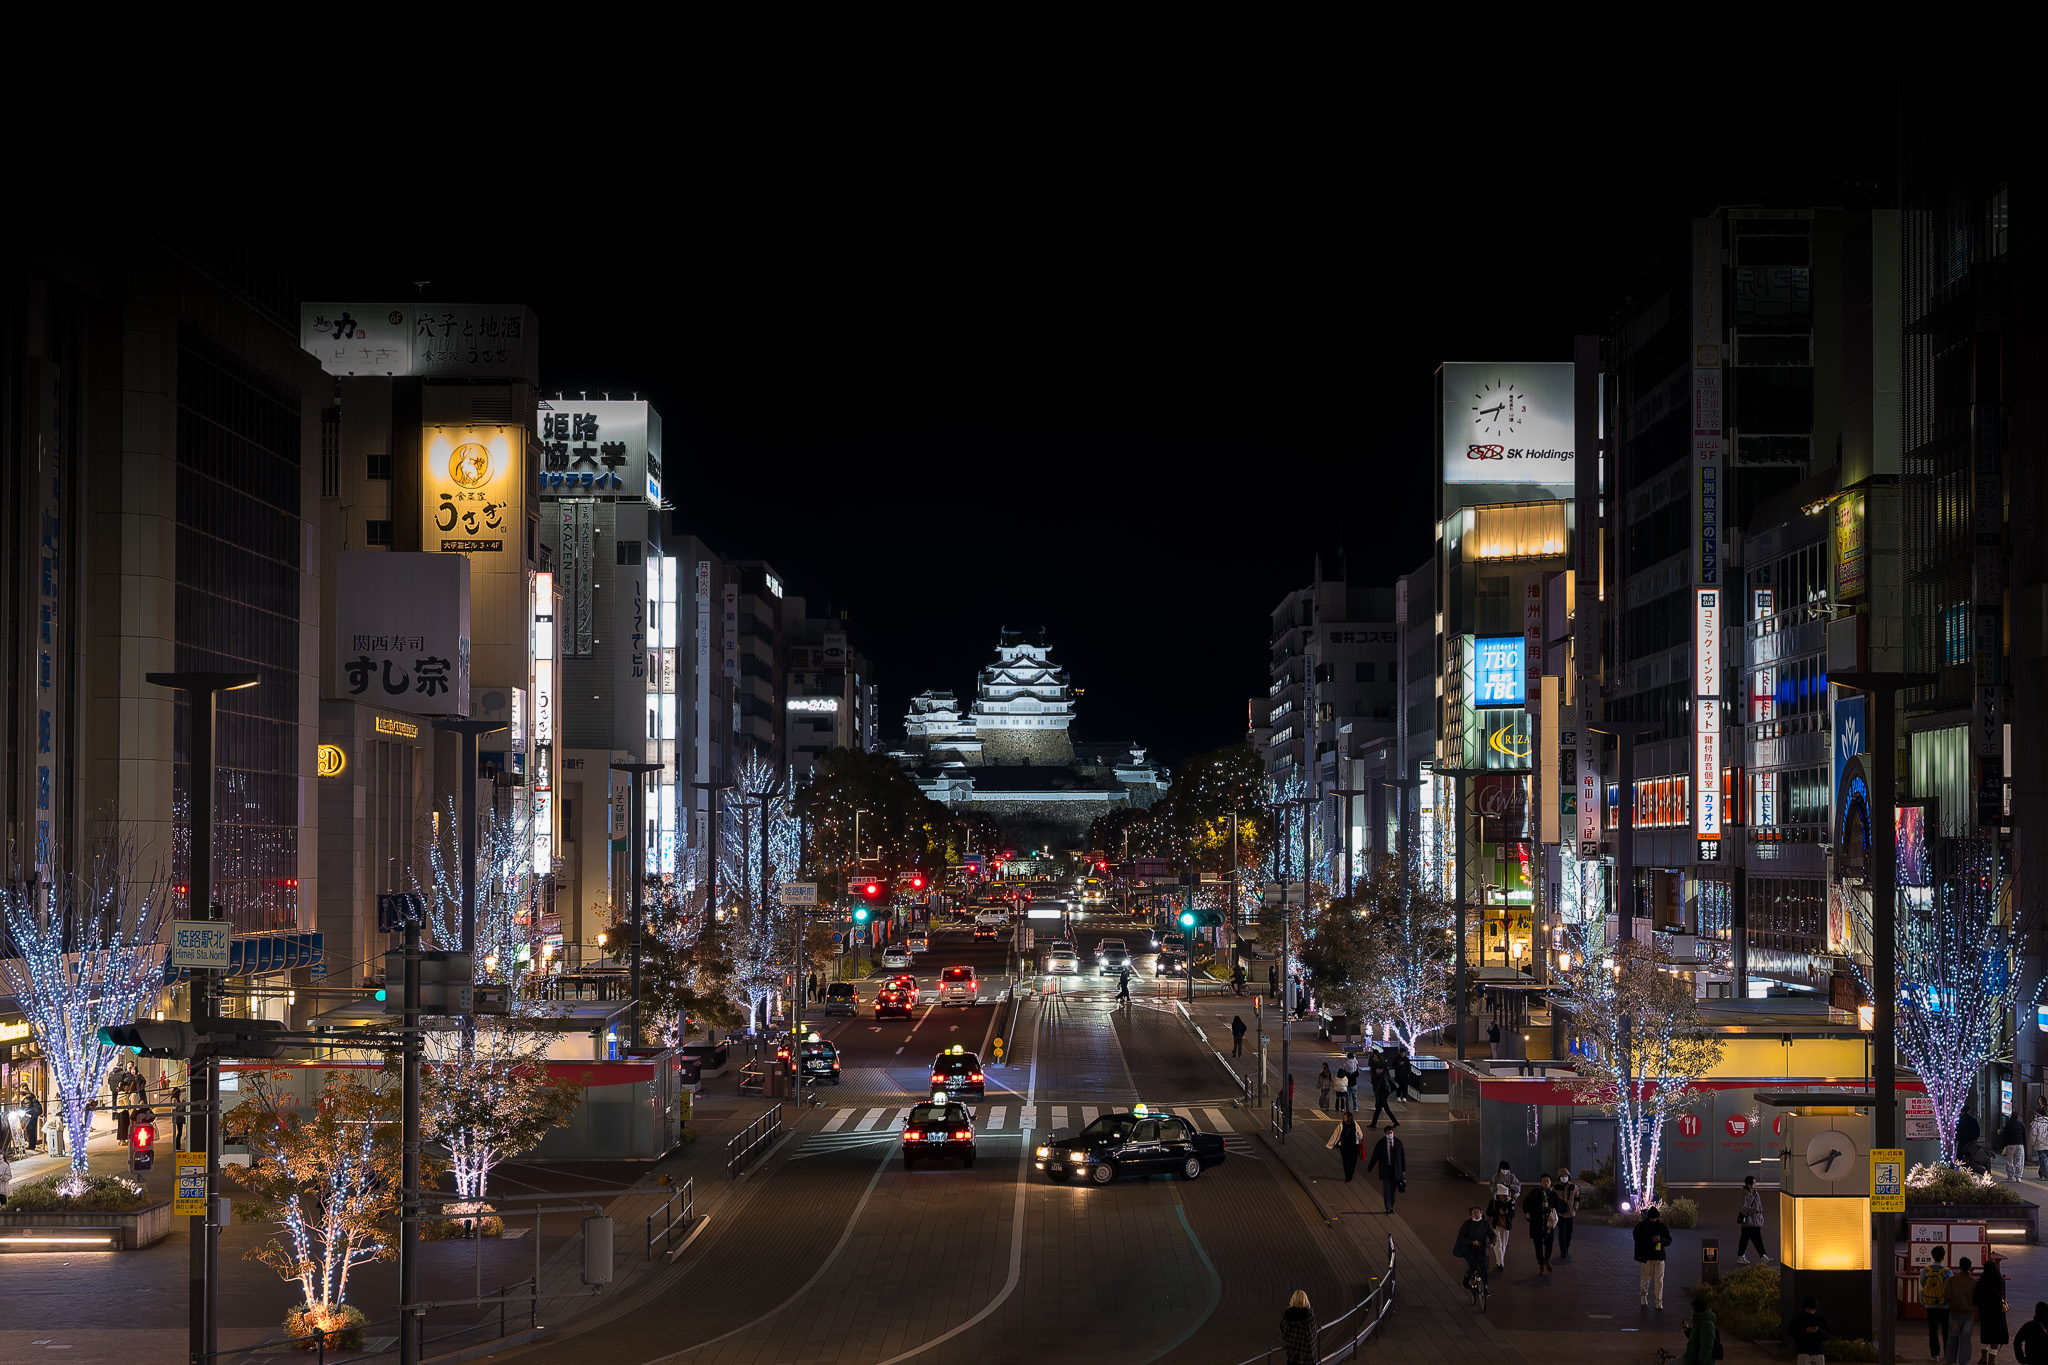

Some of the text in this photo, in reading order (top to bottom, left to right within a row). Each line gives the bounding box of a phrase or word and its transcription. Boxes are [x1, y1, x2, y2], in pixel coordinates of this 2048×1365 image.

[391, 313, 403, 323] 6F
[417, 313, 521, 339] 穴子と地酒
[466, 346, 512, 364] うさぎ
[1697, 377, 1719, 386] SBC
[543, 413, 599, 441] 姫路
[1697, 441, 1718, 449] 当ビル
[1506, 448, 1574, 461] SK Holdings
[1700, 451, 1716, 460] 5F
[434, 493, 508, 535] うさぎ
[1703, 468, 1716, 581] 個別教室のトライ
[563, 505, 573, 570] TAKAZEN
[353, 635, 424, 652] 関西寿司
[726, 612, 735, 668] 第一生命
[1483, 651, 1519, 669] TBC
[344, 656, 451, 697] すし宗
[1484, 682, 1517, 700] TBC
[1984, 688, 1995, 740] NYNY
[1982, 743, 1997, 754] 3F
[1704, 736, 1713, 789] 鍵付防音個室
[616, 786, 624, 831] りそな銀行
[1583, 776, 1595, 839] 竜のしっぽ
[1704, 794, 1713, 831] カラオケ
[1583, 844, 1596, 855] 2F
[1701, 841, 1718, 850] 受付
[1702, 850, 1717, 860] 3F
[785, 887, 814, 896] 姫路駅前
[178, 930, 225, 948] 姫路駅北
[176, 949, 195, 960] Himeji
[210, 951, 226, 961] North
[1876, 1185, 1899, 1194] おりて通行
